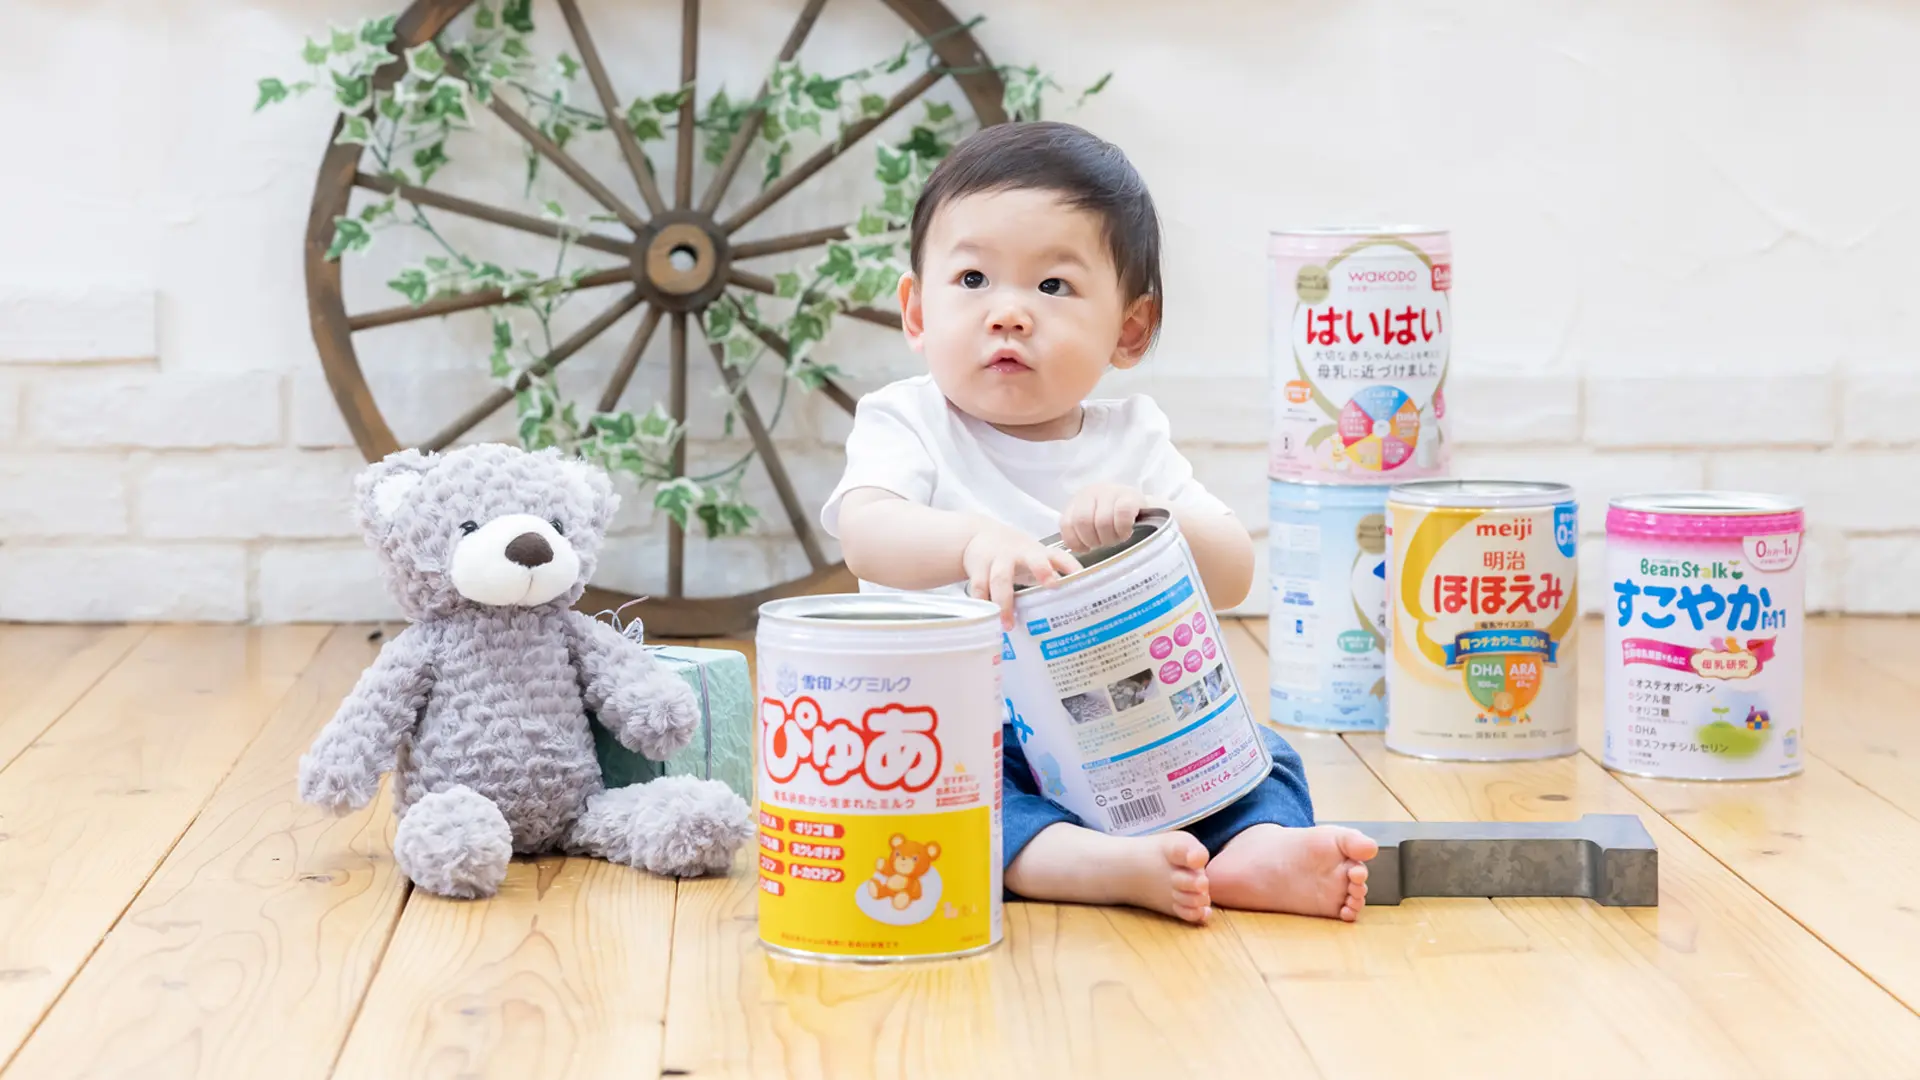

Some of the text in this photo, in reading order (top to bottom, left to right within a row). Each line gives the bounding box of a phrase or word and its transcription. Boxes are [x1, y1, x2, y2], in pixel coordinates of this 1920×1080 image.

[1307, 305, 1442, 346] はいはい
[1317, 362, 1438, 379] 母乳に近づけました
[1476, 518, 1532, 541] meiji
[1483, 550, 1526, 571] 明治
[1640, 558, 1728, 578] BeanStalk
[1434, 573, 1563, 615] ほほえみ
[1613, 579, 1772, 632] すこやか
[1761, 609, 1786, 629] M1
[1471, 663, 1504, 677] DHA
[1509, 662, 1537, 676] ARA
[1702, 658, 1749, 670] 母乳研究
[801, 674, 911, 693] 雪印メグミルク
[1635, 724, 1657, 736] DHA
[762, 695, 943, 793] ぴゅあ
[1201, 771, 1231, 793] はぐくみ
